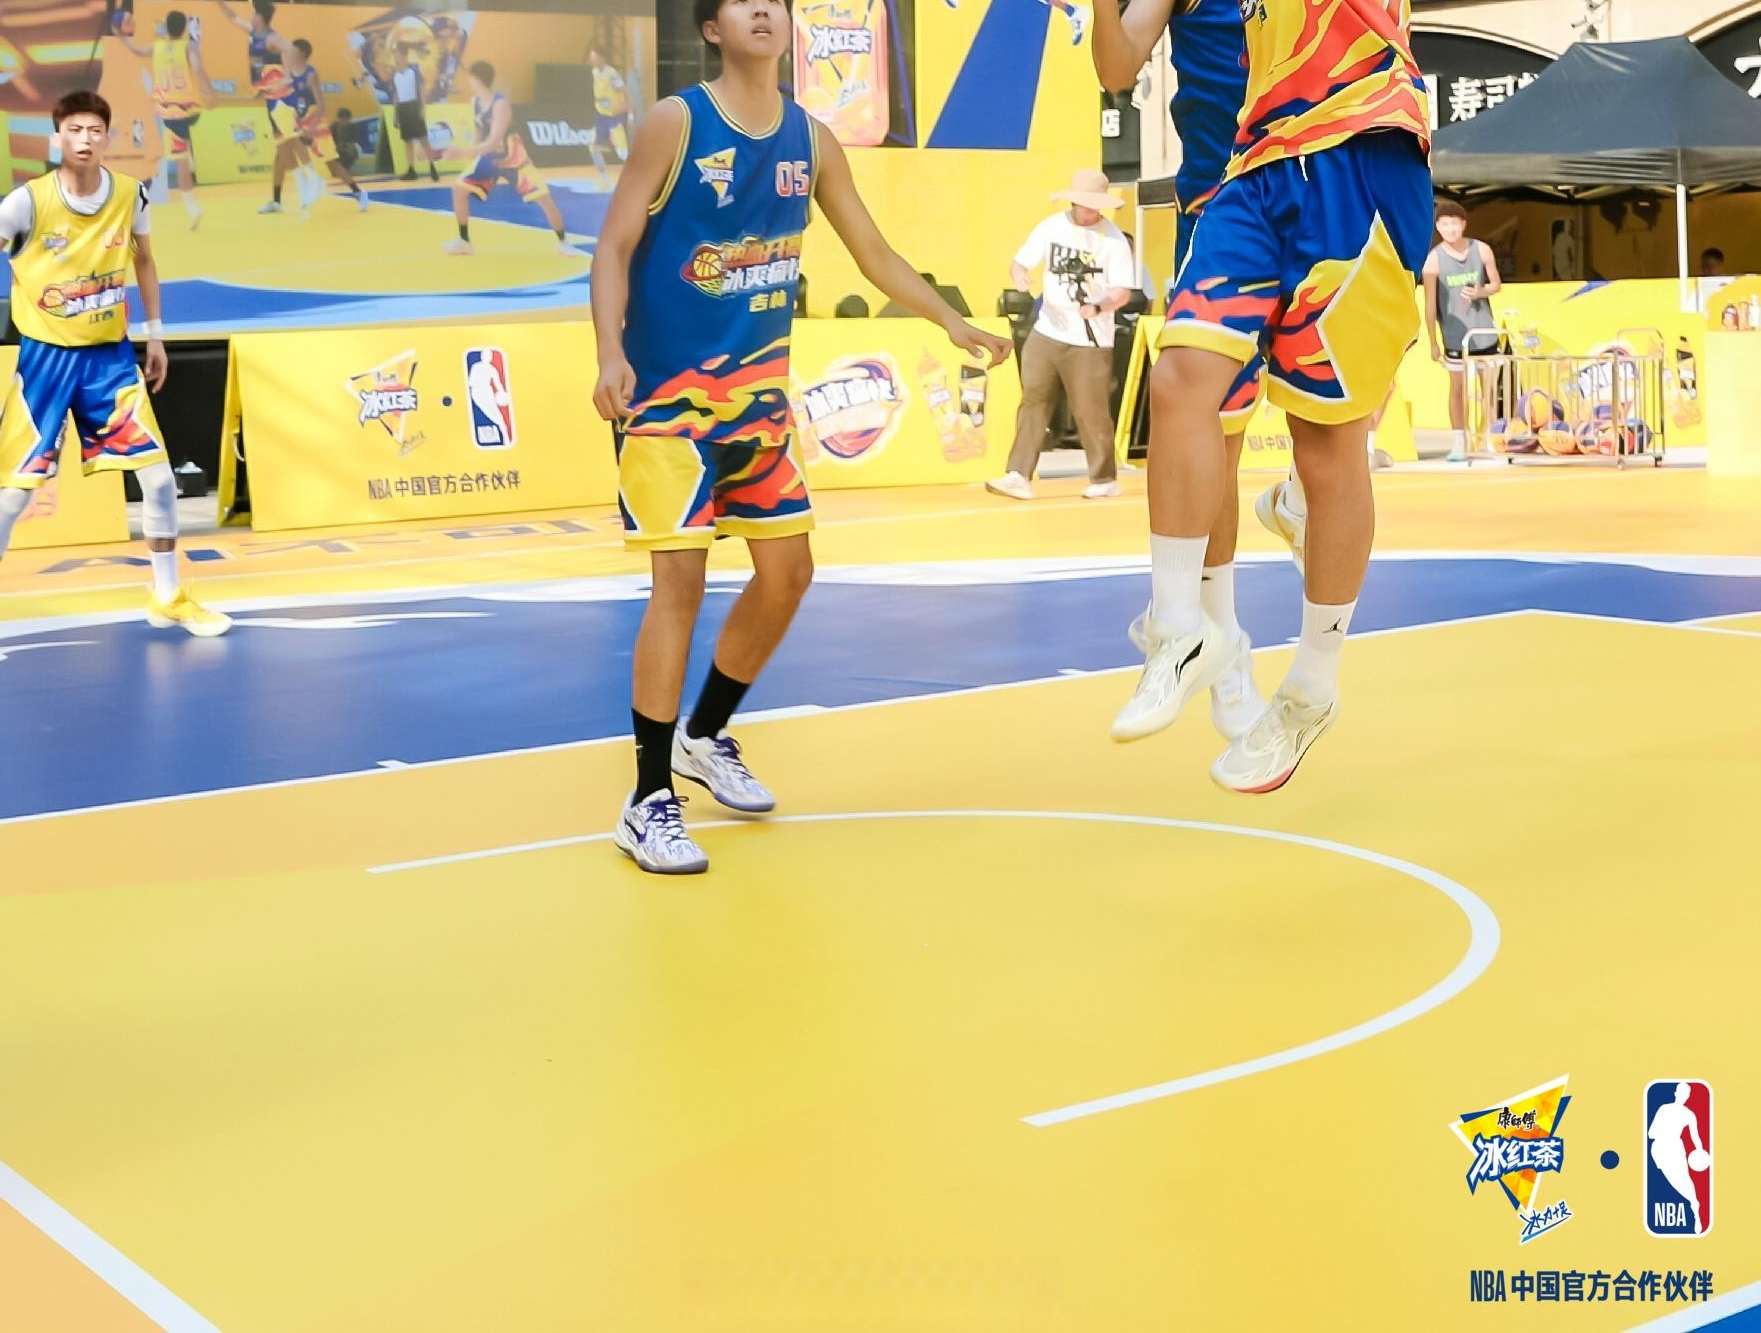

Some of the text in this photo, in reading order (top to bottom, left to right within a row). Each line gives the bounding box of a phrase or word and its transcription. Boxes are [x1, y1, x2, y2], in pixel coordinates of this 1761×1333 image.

[806, 23, 873, 67] 冰红茶
[776, 160, 810, 197] 05
[358, 389, 418, 428] 冰红茶
[1265, 434, 1293, 452] 中国
[368, 467, 521, 501] NBA 中国官方合作伙伴
